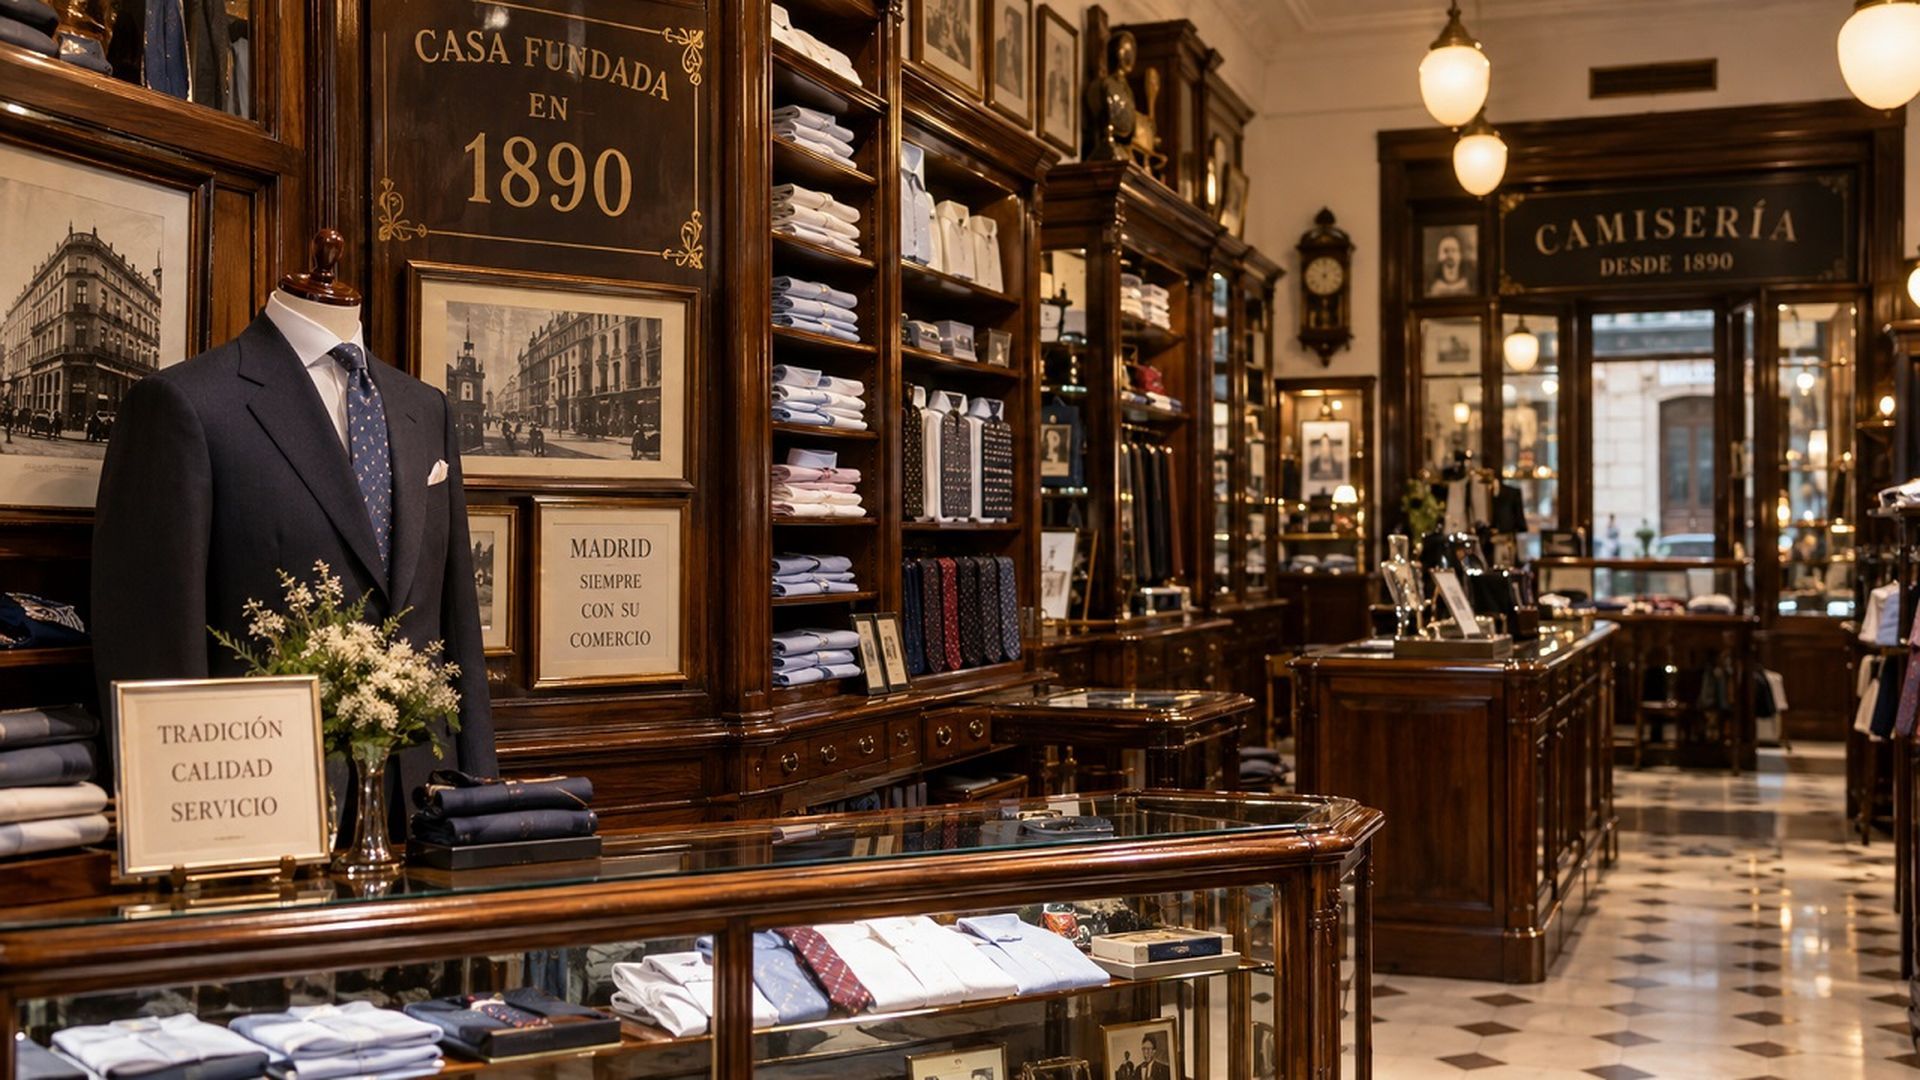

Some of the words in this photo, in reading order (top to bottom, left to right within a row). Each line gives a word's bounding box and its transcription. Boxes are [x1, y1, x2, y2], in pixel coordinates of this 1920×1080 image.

[414, 29, 511, 64] CASA
[523, 36, 670, 101] FUNDADA
[529, 92, 569, 121] EN
[464, 132, 632, 217] 1890
[1534, 199, 1798, 256] CAMISERÍA
[1599, 254, 1672, 277] DESDE
[1683, 252, 1734, 274] 1890
[570, 538, 652, 559] MADRID
[579, 573, 642, 590] SIEMPRE
[581, 602, 615, 619] CON
[620, 602, 641, 618] SU
[569, 630, 652, 649] COMERCIO
[157, 715, 283, 744] TRADICIÓN
[171, 758, 273, 783] CALIDAD
[171, 796, 278, 822] SERVICIO
